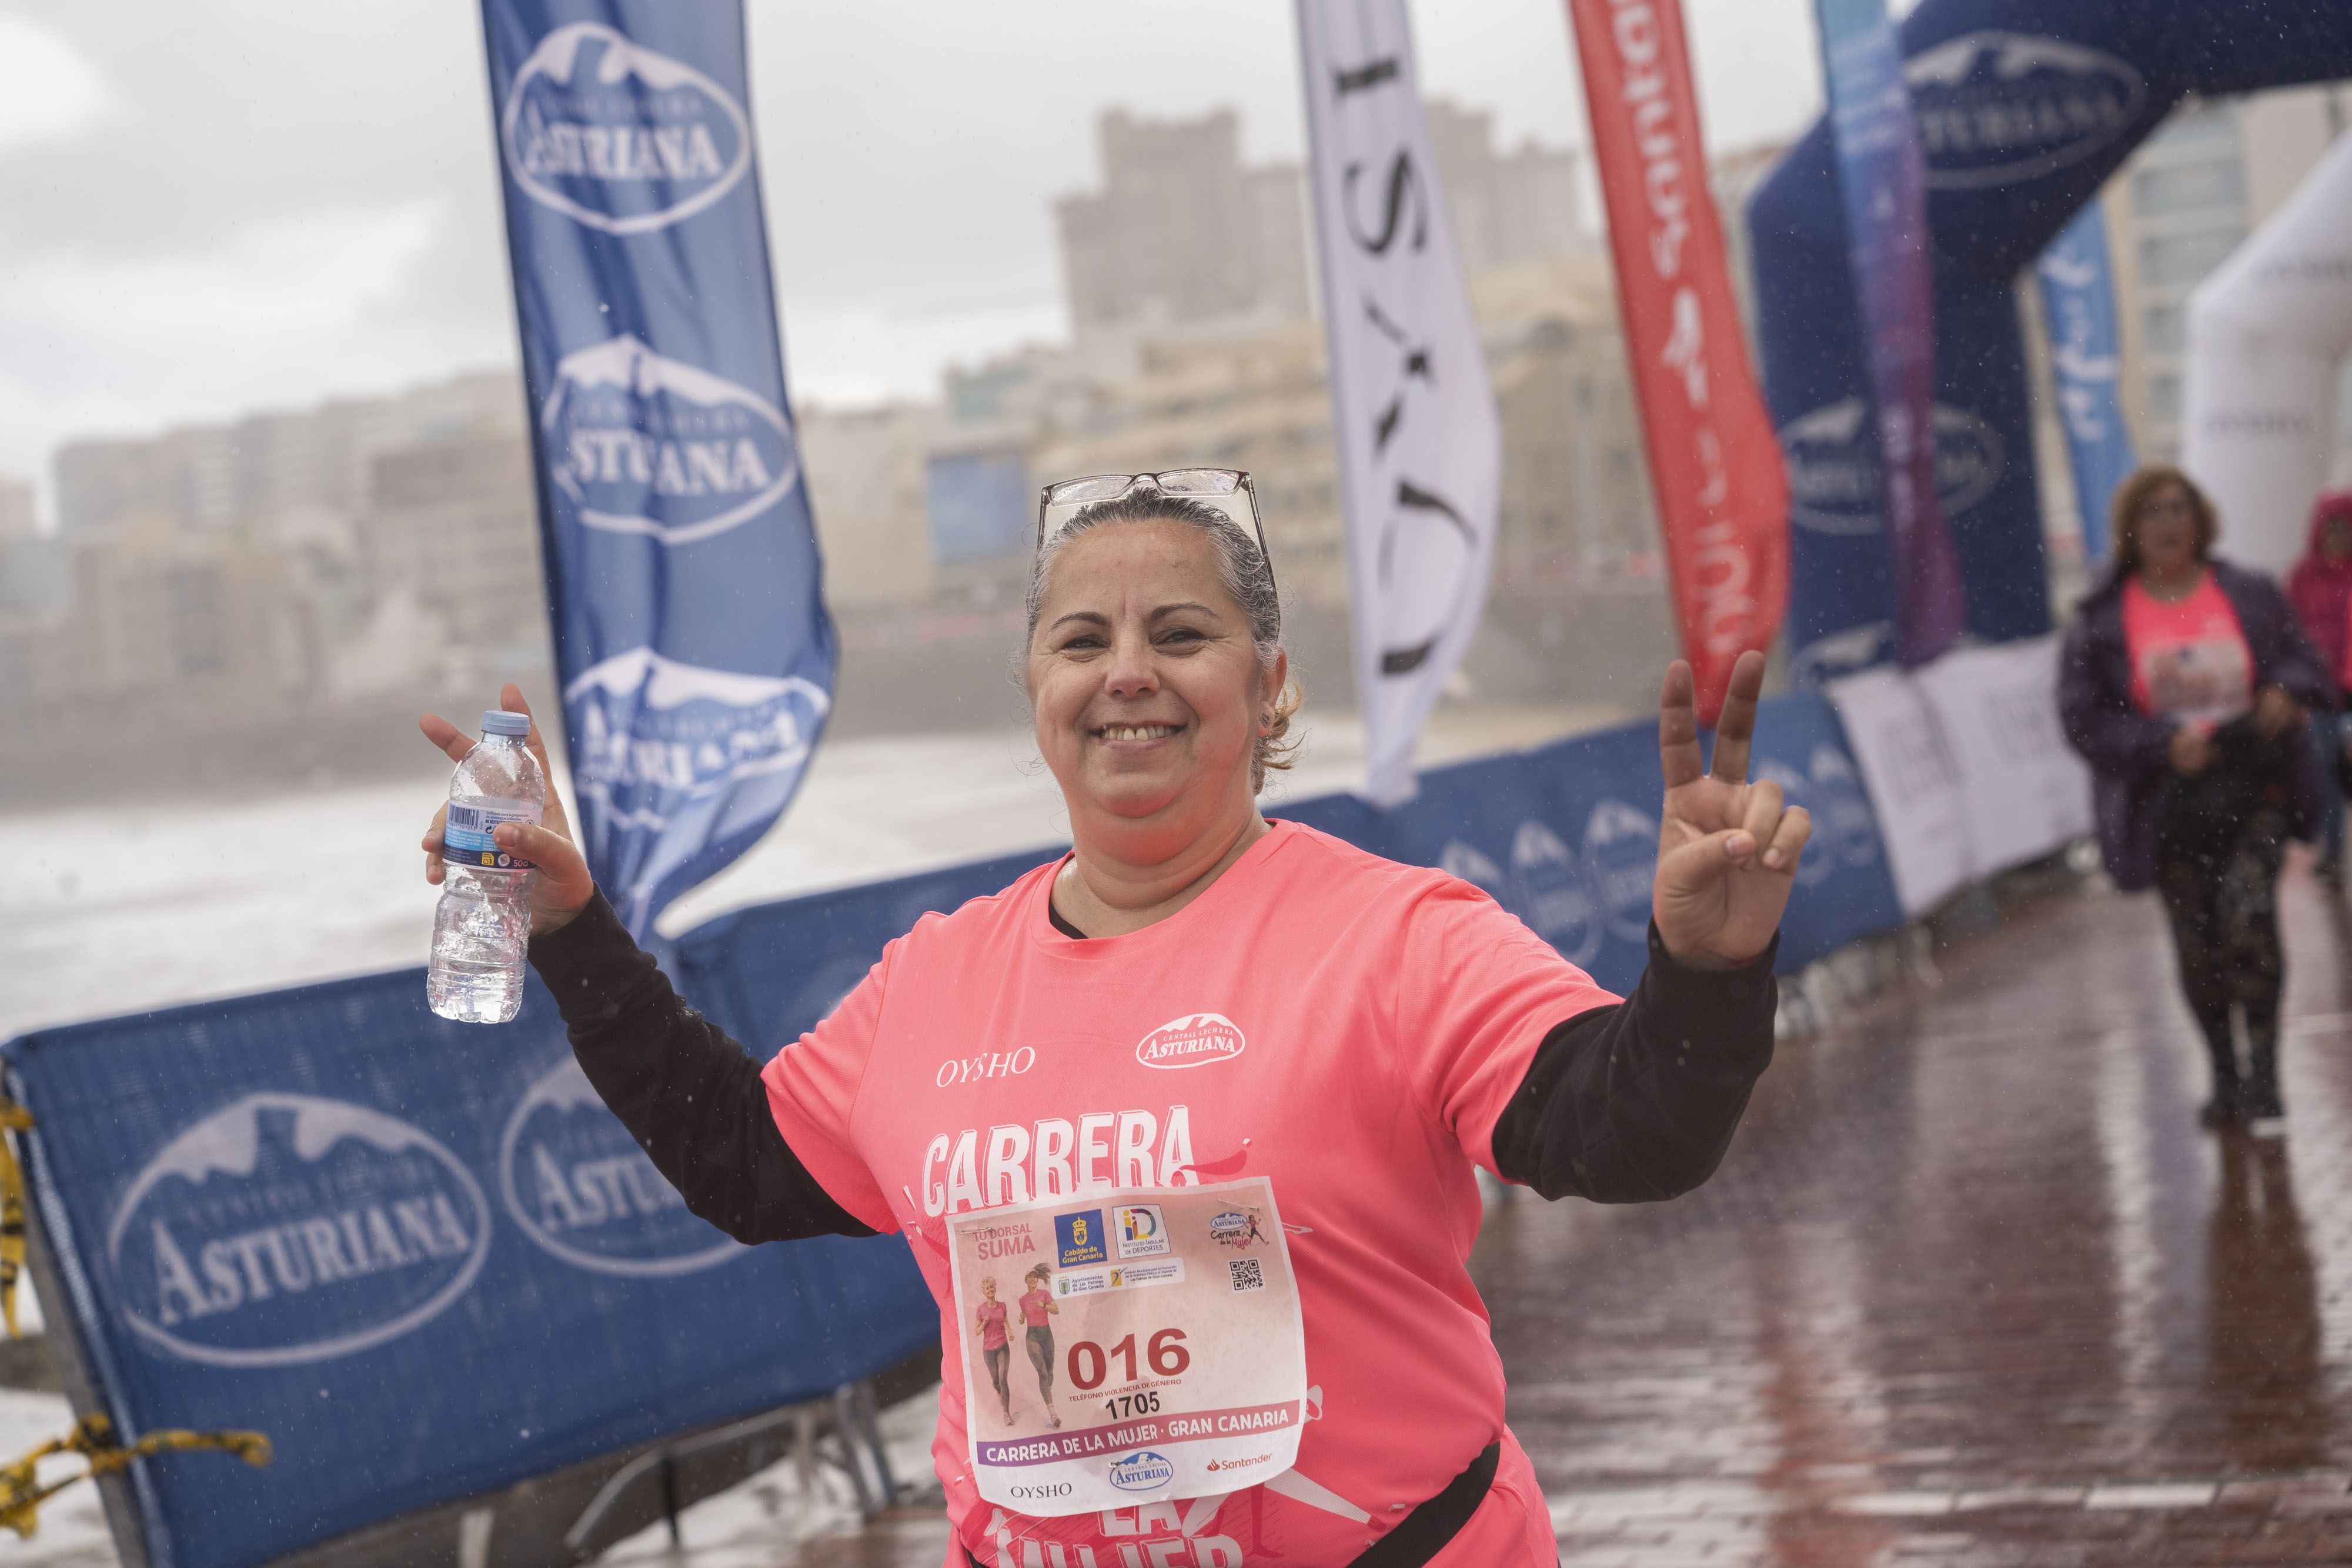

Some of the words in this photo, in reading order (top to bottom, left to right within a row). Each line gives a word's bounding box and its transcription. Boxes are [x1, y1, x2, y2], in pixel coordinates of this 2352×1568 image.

[1607, 0, 1692, 281] Santa
[1163, 1032, 1196, 1041] CENTRAL
[1199, 1027, 1233, 1036] LECHERA
[1143, 1035, 1235, 1059] ASTURIANA
[936, 1046, 1035, 1088] OYSHO
[923, 1104, 1201, 1217] CARRERA
[973, 1229, 987, 1242] TU
[990, 1223, 1033, 1239] DORSAL
[1211, 1230, 1241, 1242] Carrera
[1231, 1236, 1251, 1249] Mujer
[151, 1190, 469, 1325] ASTURIANA
[978, 1235, 1035, 1261] SUMA
[1064, 1248, 1088, 1256] Cabildo
[1078, 1252, 1103, 1261] Canaria
[1132, 1245, 1163, 1253] DEPORTES
[1068, 1328, 1190, 1390] 016
[1068, 1392, 1103, 1402] TELÉFONO
[1104, 1385, 1140, 1396] VIOLENCIA
[1151, 1379, 1181, 1388] GÉNERO
[1105, 1391, 1160, 1420] 1705
[986, 1443, 1060, 1462] CARRERA
[1063, 1438, 1082, 1454] DE
[1084, 1434, 1105, 1450] LA
[1107, 1423, 1158, 1447] MUJER
[1168, 1417, 1212, 1437] GRAN
[1218, 1409, 1289, 1432] CANARIA
[1222, 1453, 1272, 1470] Santander
[1117, 1467, 1170, 1485] ASTURIANA
[1010, 1483, 1072, 1499] OYSHO
